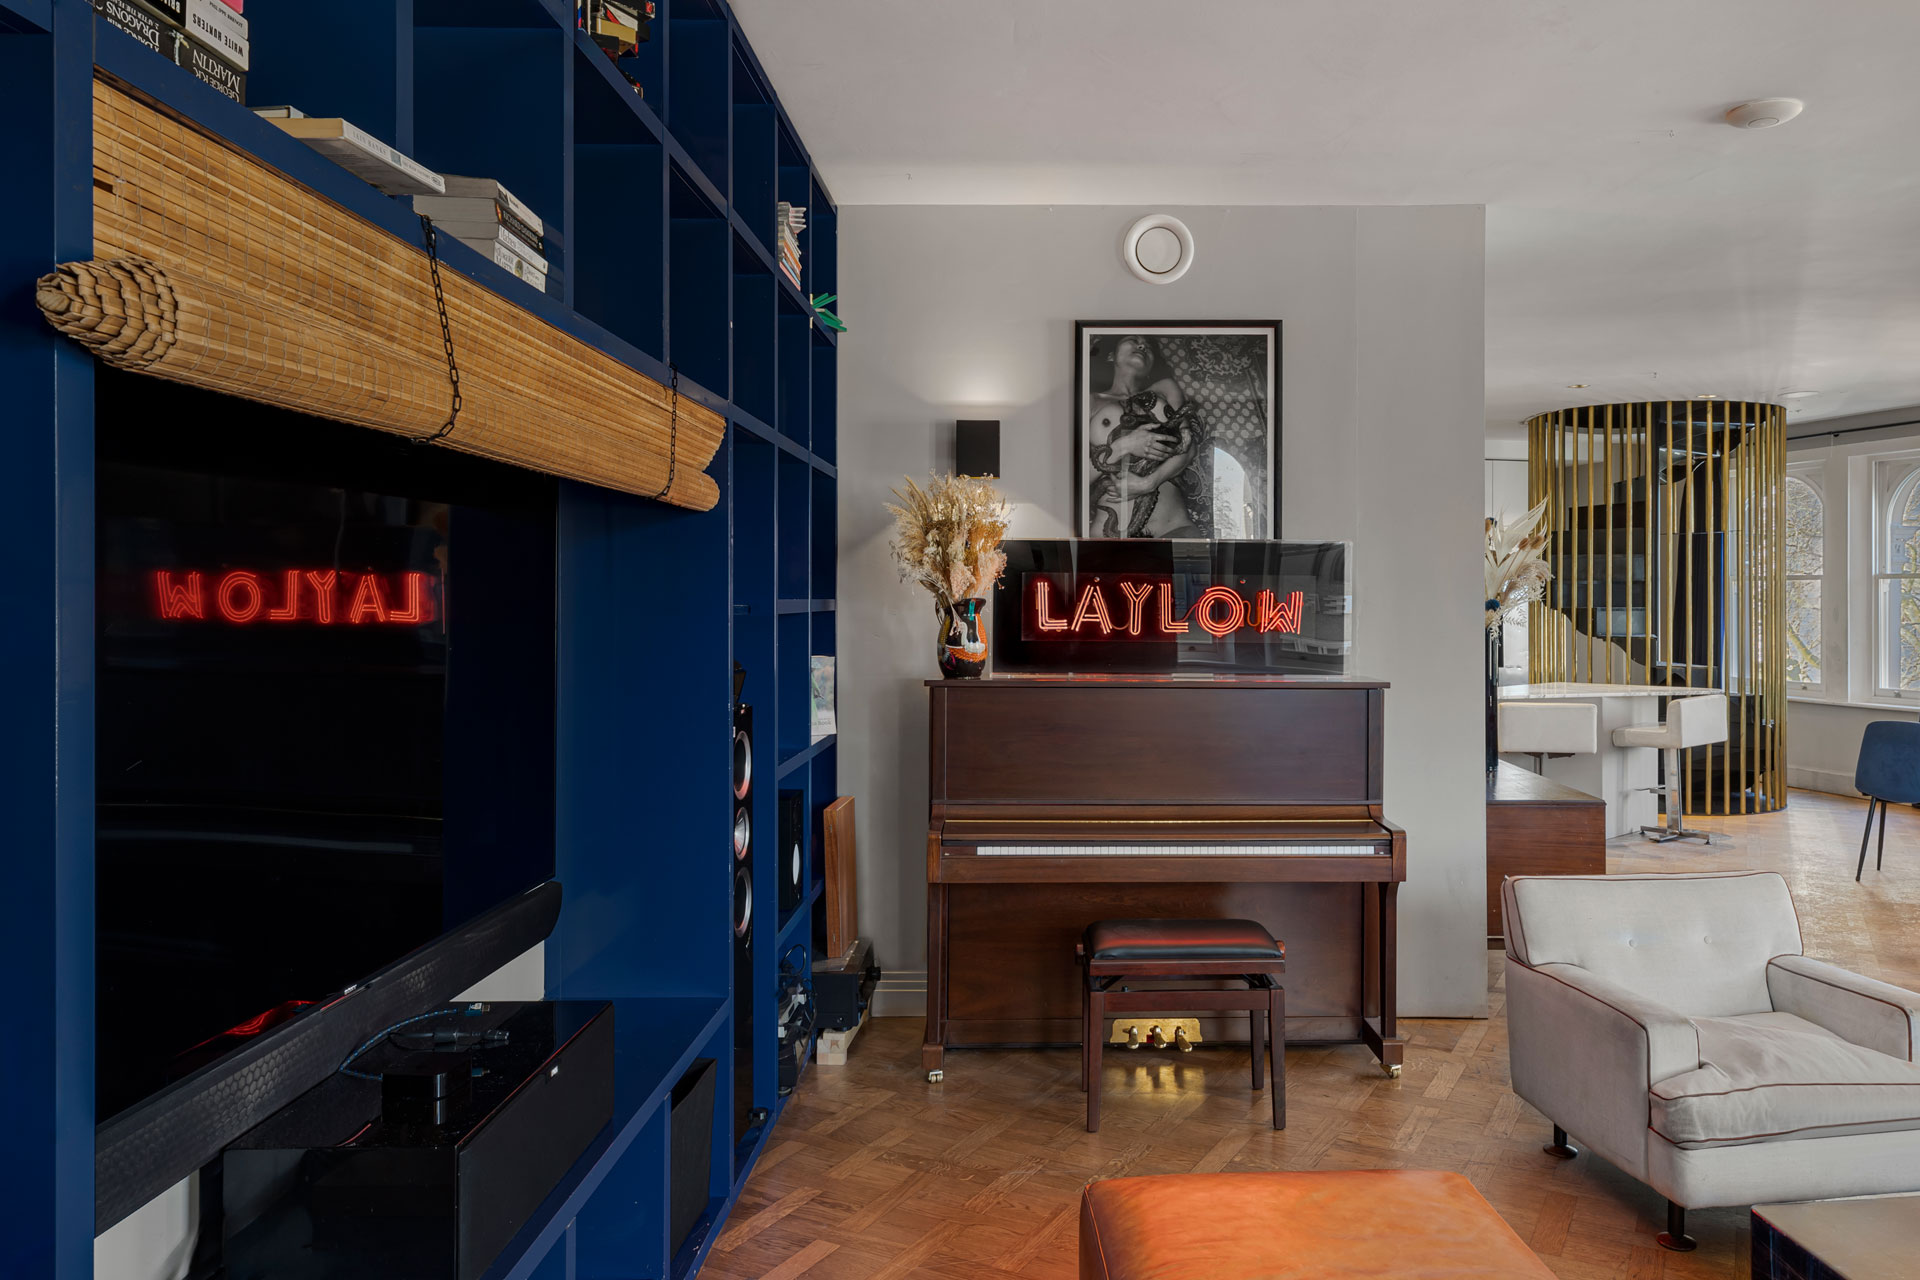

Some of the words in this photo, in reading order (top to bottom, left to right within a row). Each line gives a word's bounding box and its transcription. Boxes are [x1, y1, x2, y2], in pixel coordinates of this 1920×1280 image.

[106, 1, 160, 47] DRAGONS
[192, 13, 222, 41] HUNTERS
[224, 35, 244, 57] WHITE
[192, 49, 240, 93] MARTIN
[209, 78, 240, 103] GEORGE
[1036, 582, 1303, 635] LAYLOW
